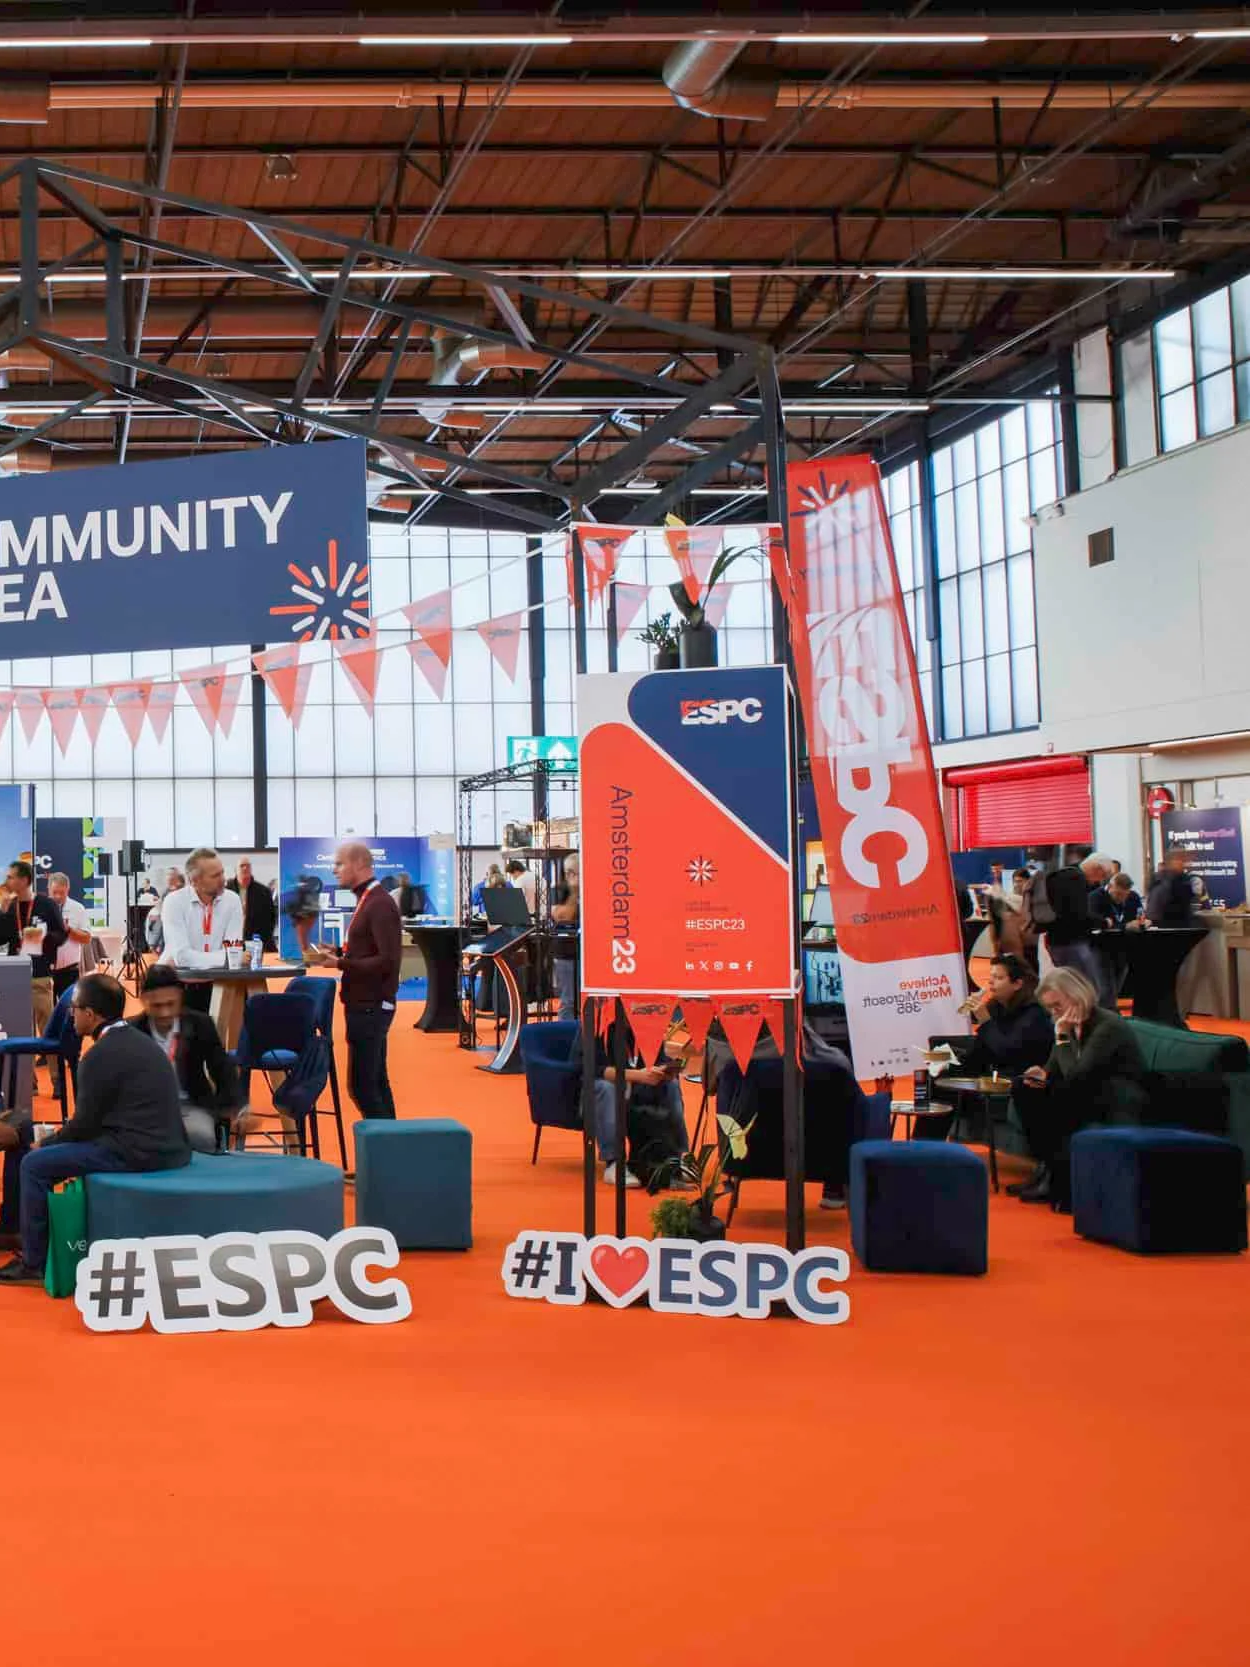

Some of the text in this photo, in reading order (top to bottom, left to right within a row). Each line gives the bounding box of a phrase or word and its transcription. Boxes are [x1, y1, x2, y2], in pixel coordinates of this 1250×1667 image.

[680, 697, 763, 725] ESPC
[610, 785, 637, 975] Amsterdam23
[685, 919, 746, 930] #ESPC23
[89, 1238, 398, 1319] #ESPC
[658, 1249, 842, 1315] ESPC
